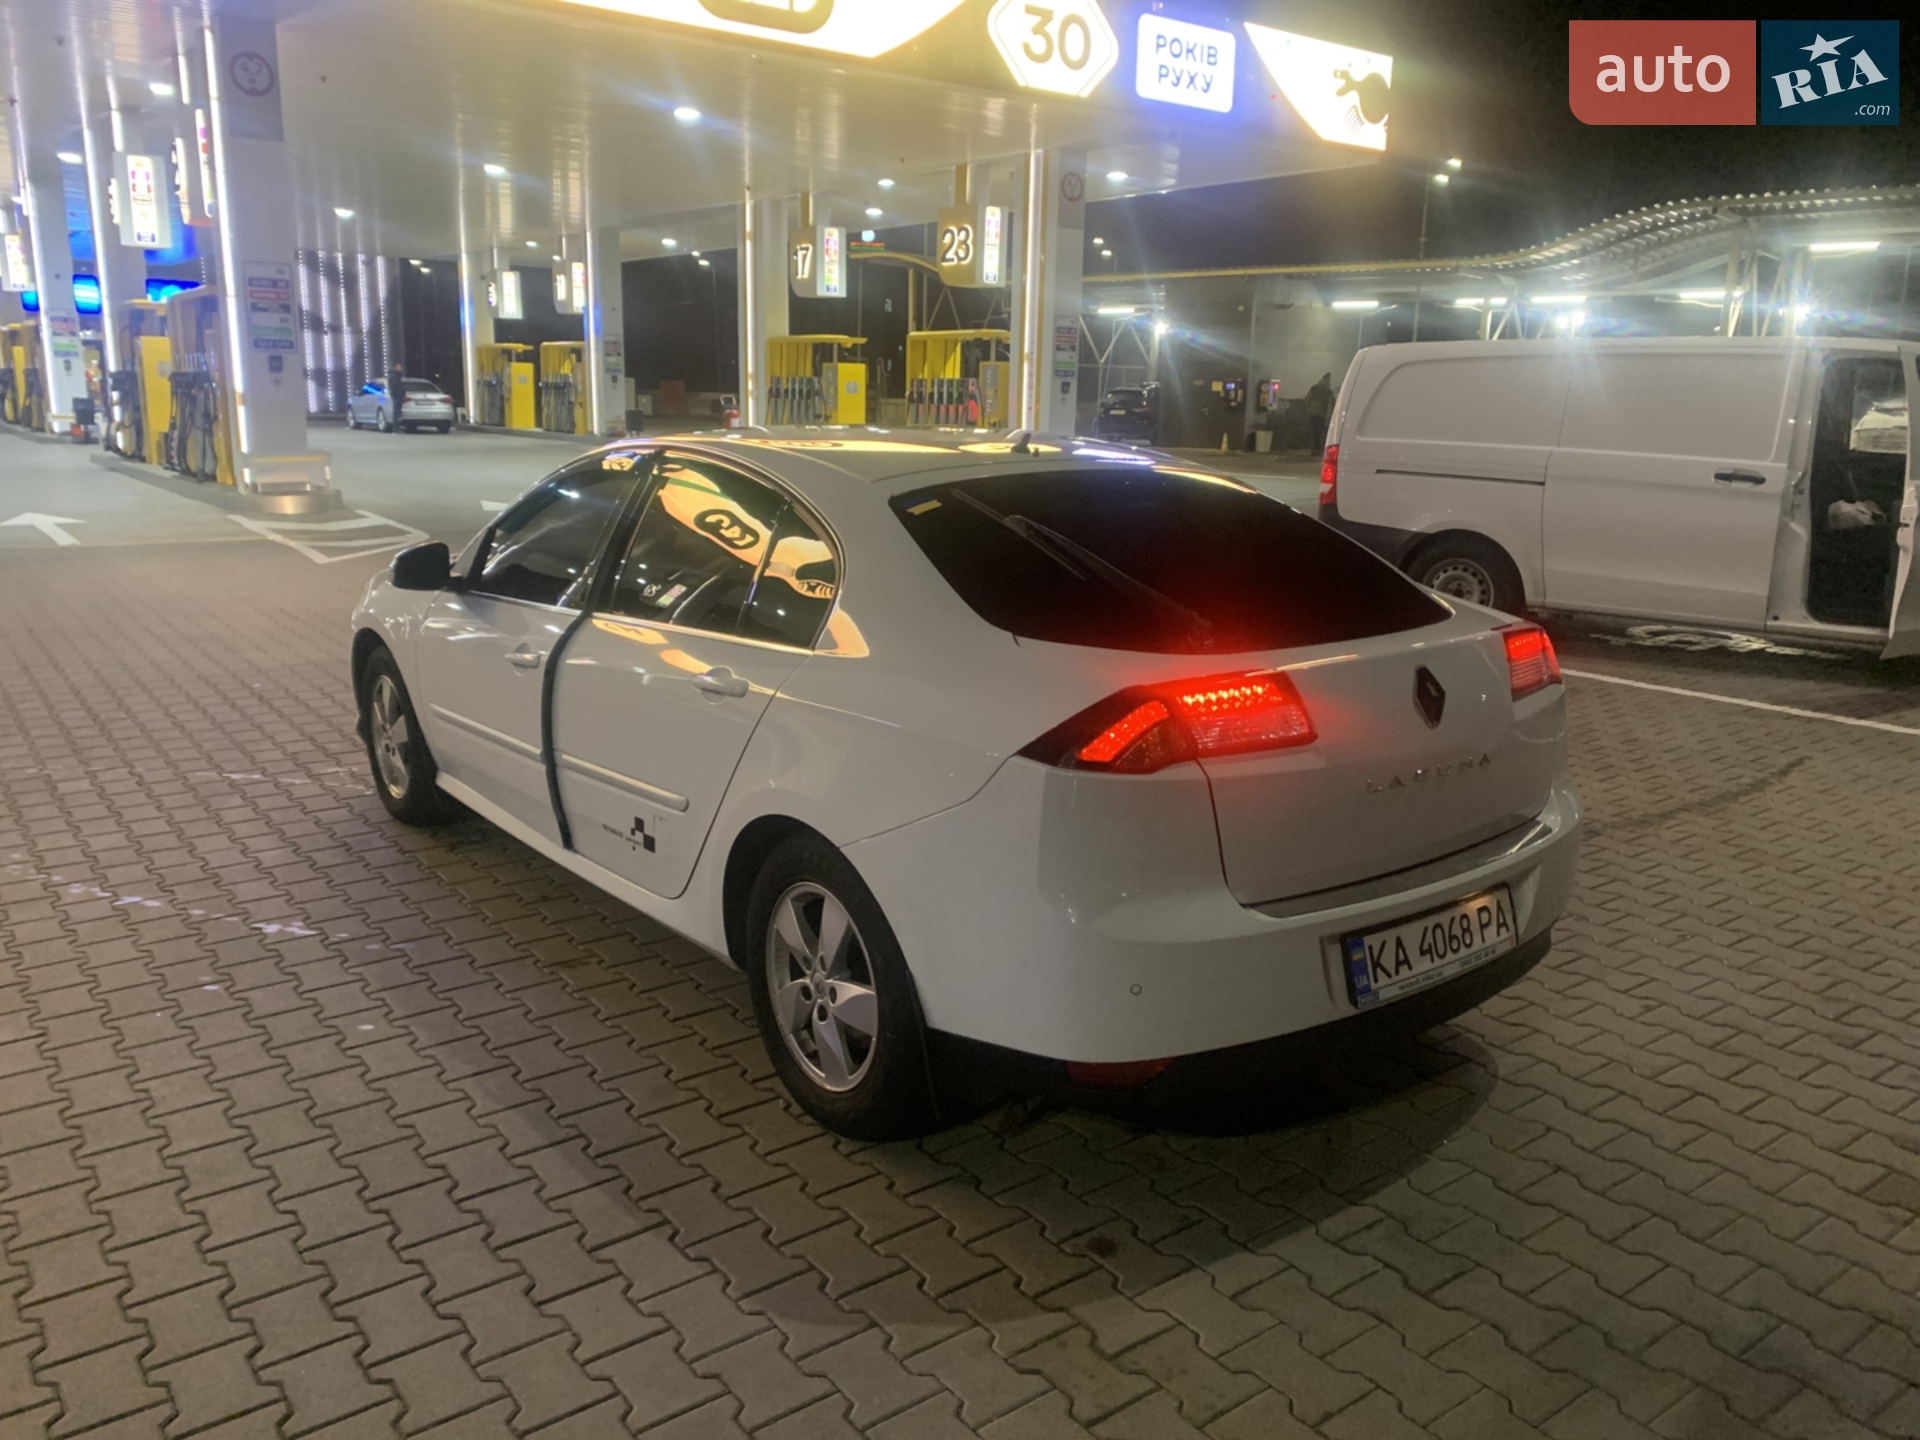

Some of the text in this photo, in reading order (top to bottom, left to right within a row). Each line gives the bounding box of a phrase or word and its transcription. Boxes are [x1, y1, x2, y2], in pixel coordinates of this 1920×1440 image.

[1022, 4, 1092, 71] 30
[1156, 33, 1218, 67] РОКІВ
[1158, 64, 1214, 93] РУХУ
[793, 243, 813, 280] 17
[941, 224, 974, 266] 23
[1366, 753, 1492, 794] LAGUNA
[1368, 899, 1510, 984] KA 4068 PA
